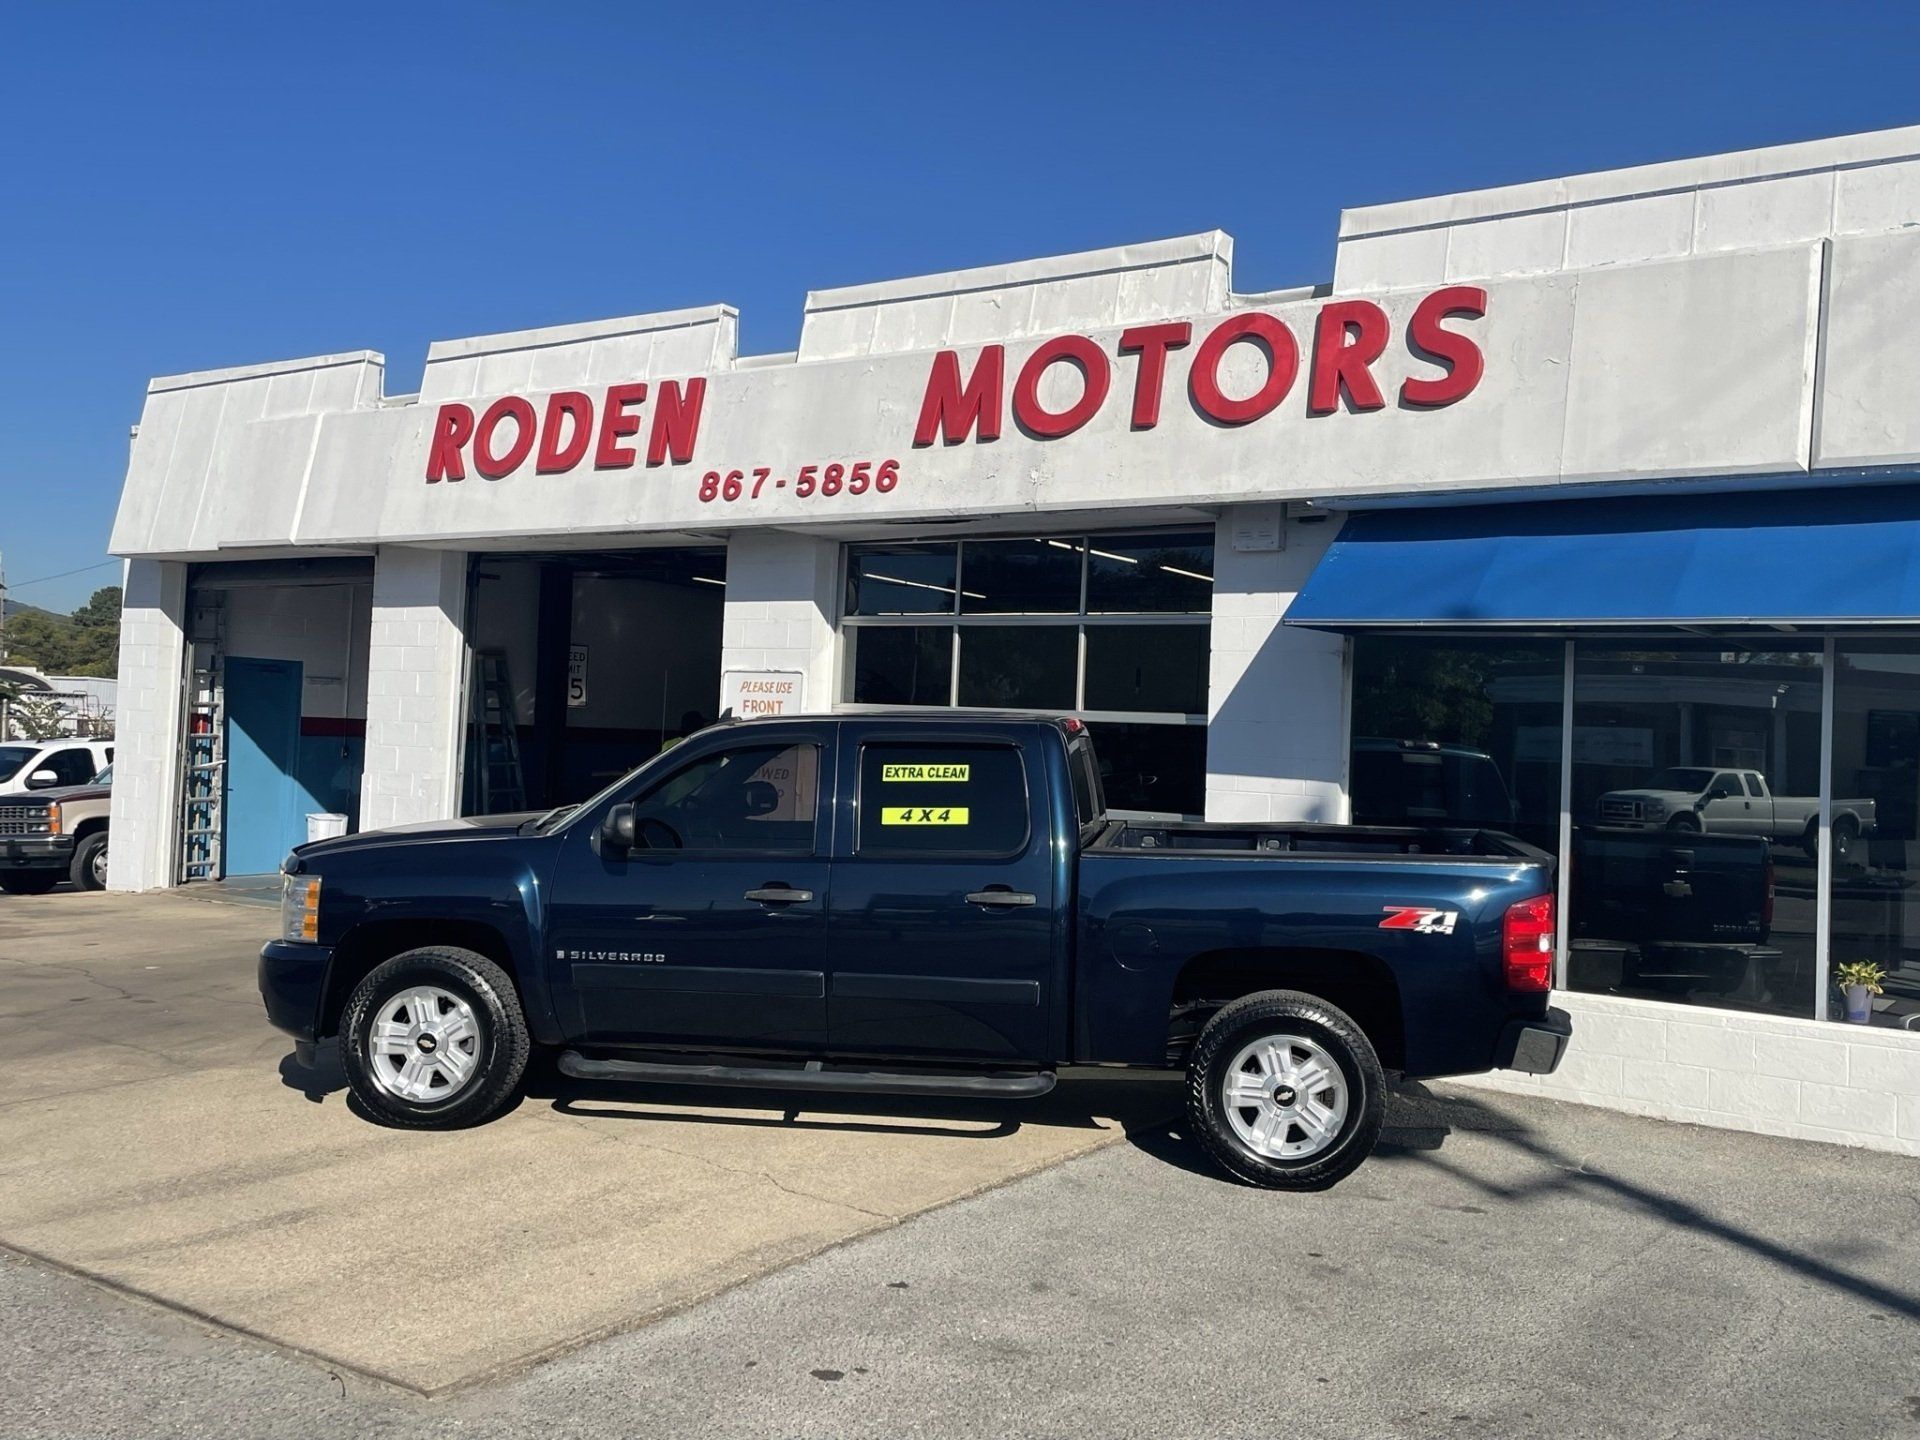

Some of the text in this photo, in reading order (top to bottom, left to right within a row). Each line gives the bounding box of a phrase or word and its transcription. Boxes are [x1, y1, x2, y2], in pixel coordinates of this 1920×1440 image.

[426, 286, 1488, 484] RODEN MOTORS
[699, 459, 901, 503] 867-5856
[570, 652, 585, 661] EED
[570, 678, 583, 700] 5
[740, 681, 793, 694] PLEASE USE
[742, 700, 783, 715] FRONT
[758, 768, 790, 780] WED
[885, 767, 967, 779] EXTRA CLEAN
[1379, 906, 1459, 928] Z71
[570, 951, 665, 962] SILVERADO
